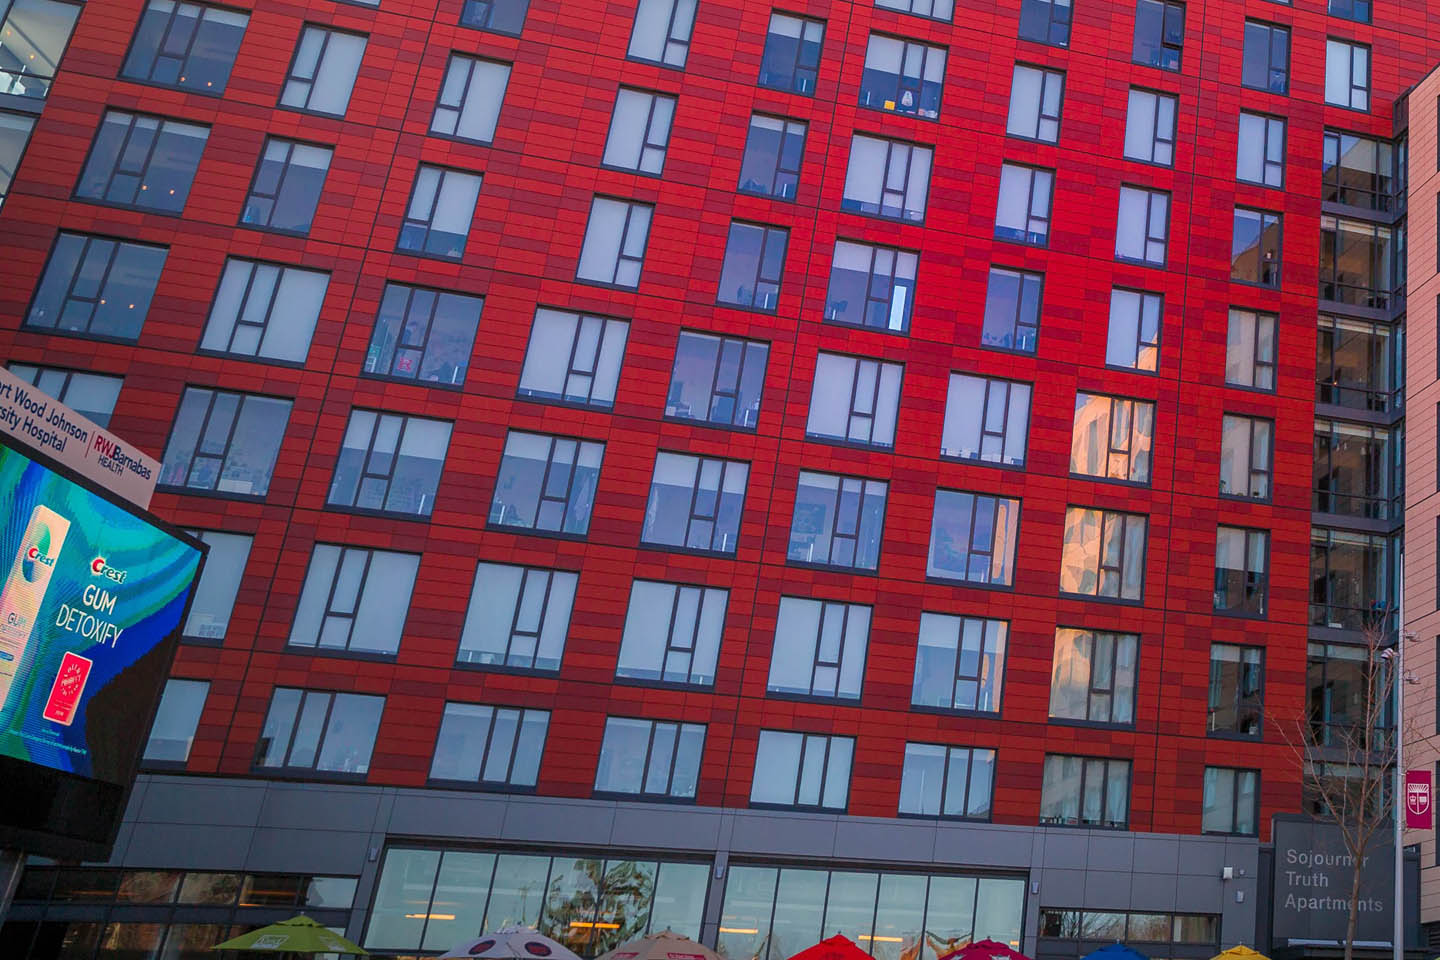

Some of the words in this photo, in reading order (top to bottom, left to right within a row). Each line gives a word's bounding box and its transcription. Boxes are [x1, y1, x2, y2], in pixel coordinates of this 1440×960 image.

[0, 381, 12, 399] rt
[14, 386, 47, 418] Wood
[45, 408, 88, 443] Johnson
[0, 405, 21, 431] sity
[22, 416, 68, 453] Hospital
[98, 454, 125, 477] HEALTH
[28, 547, 55, 567] Crest
[92, 558, 126, 583] Crest
[83, 584, 118, 616] GUM
[56, 603, 124, 649] DETOXIFY
[1285, 871, 1329, 888] Truth
